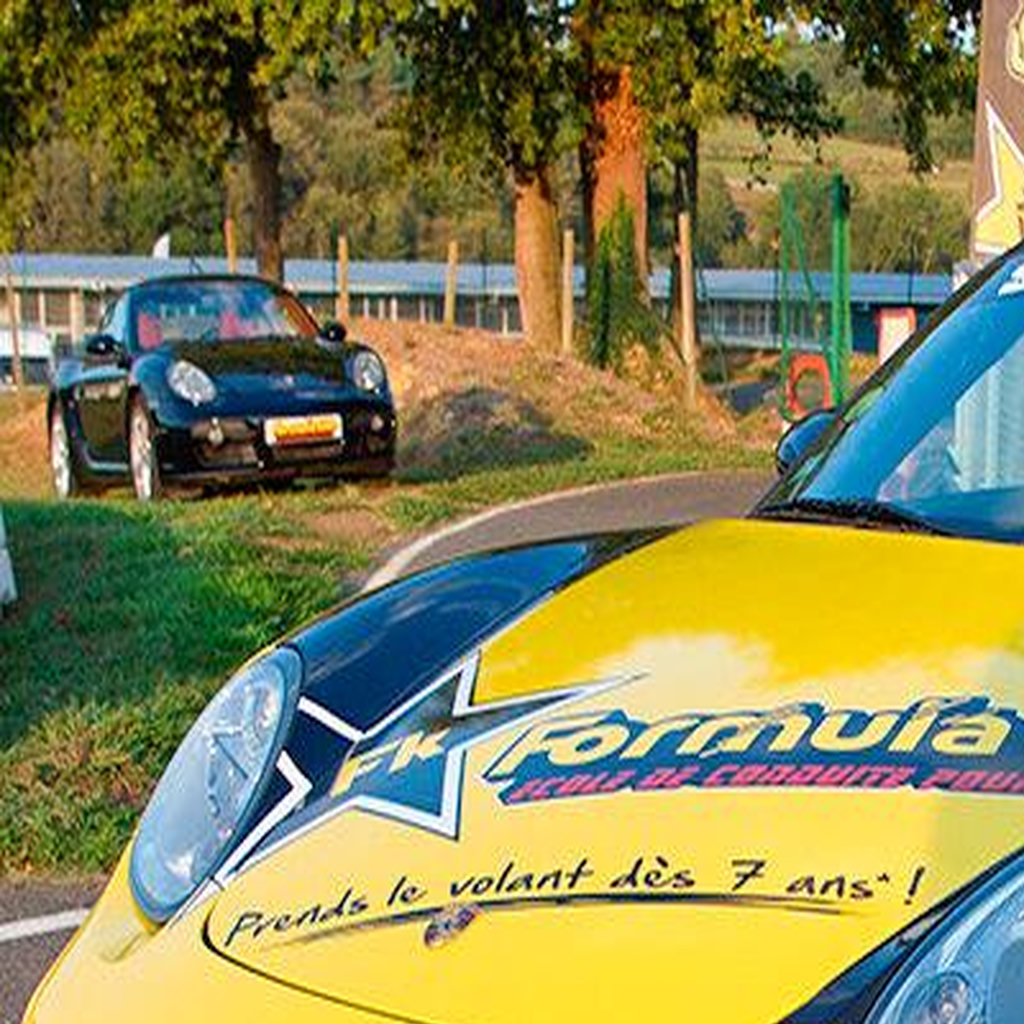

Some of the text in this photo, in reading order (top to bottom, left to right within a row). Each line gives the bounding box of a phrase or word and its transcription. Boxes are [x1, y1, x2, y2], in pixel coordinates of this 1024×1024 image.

[485, 697, 1011, 781] Formula
[224, 887, 369, 947] Prends
[386, 876, 426, 906] le
[450, 859, 594, 897] volant
[610, 856, 696, 889] dès
[730, 858, 767, 892] 7
